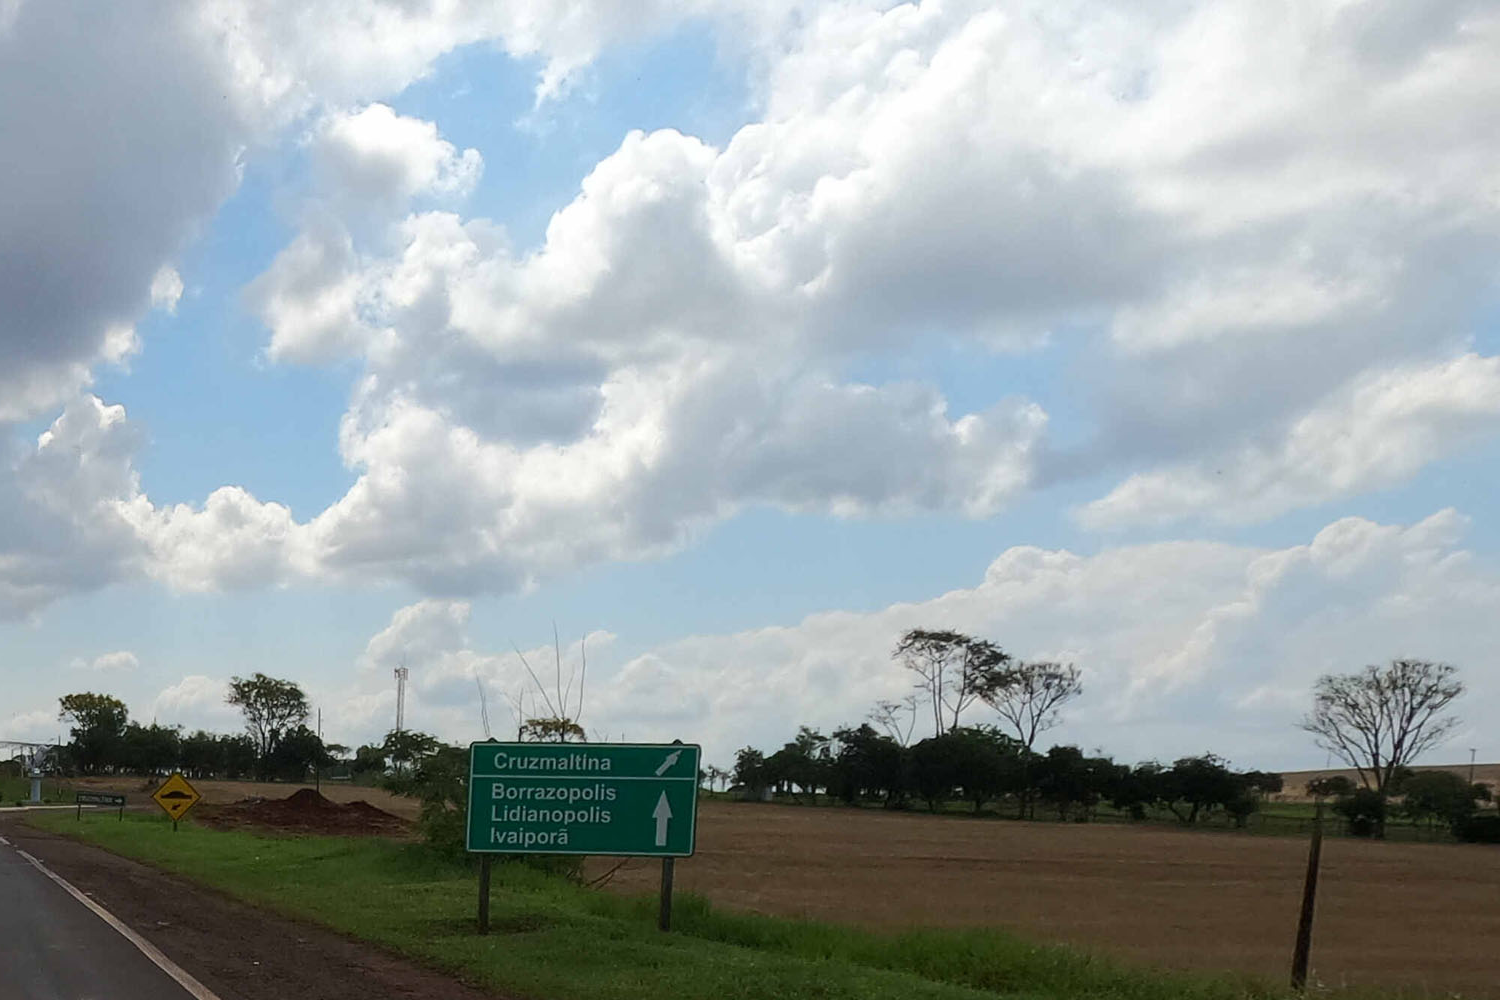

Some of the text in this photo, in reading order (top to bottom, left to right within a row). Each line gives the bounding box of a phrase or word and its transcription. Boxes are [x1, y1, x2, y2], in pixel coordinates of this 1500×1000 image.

[493, 752, 611, 771] Cruzmaltina
[491, 783, 617, 804] Borrazopolis
[491, 805, 611, 825] Lidianopolis
[490, 827, 568, 848] Ivaiporã
